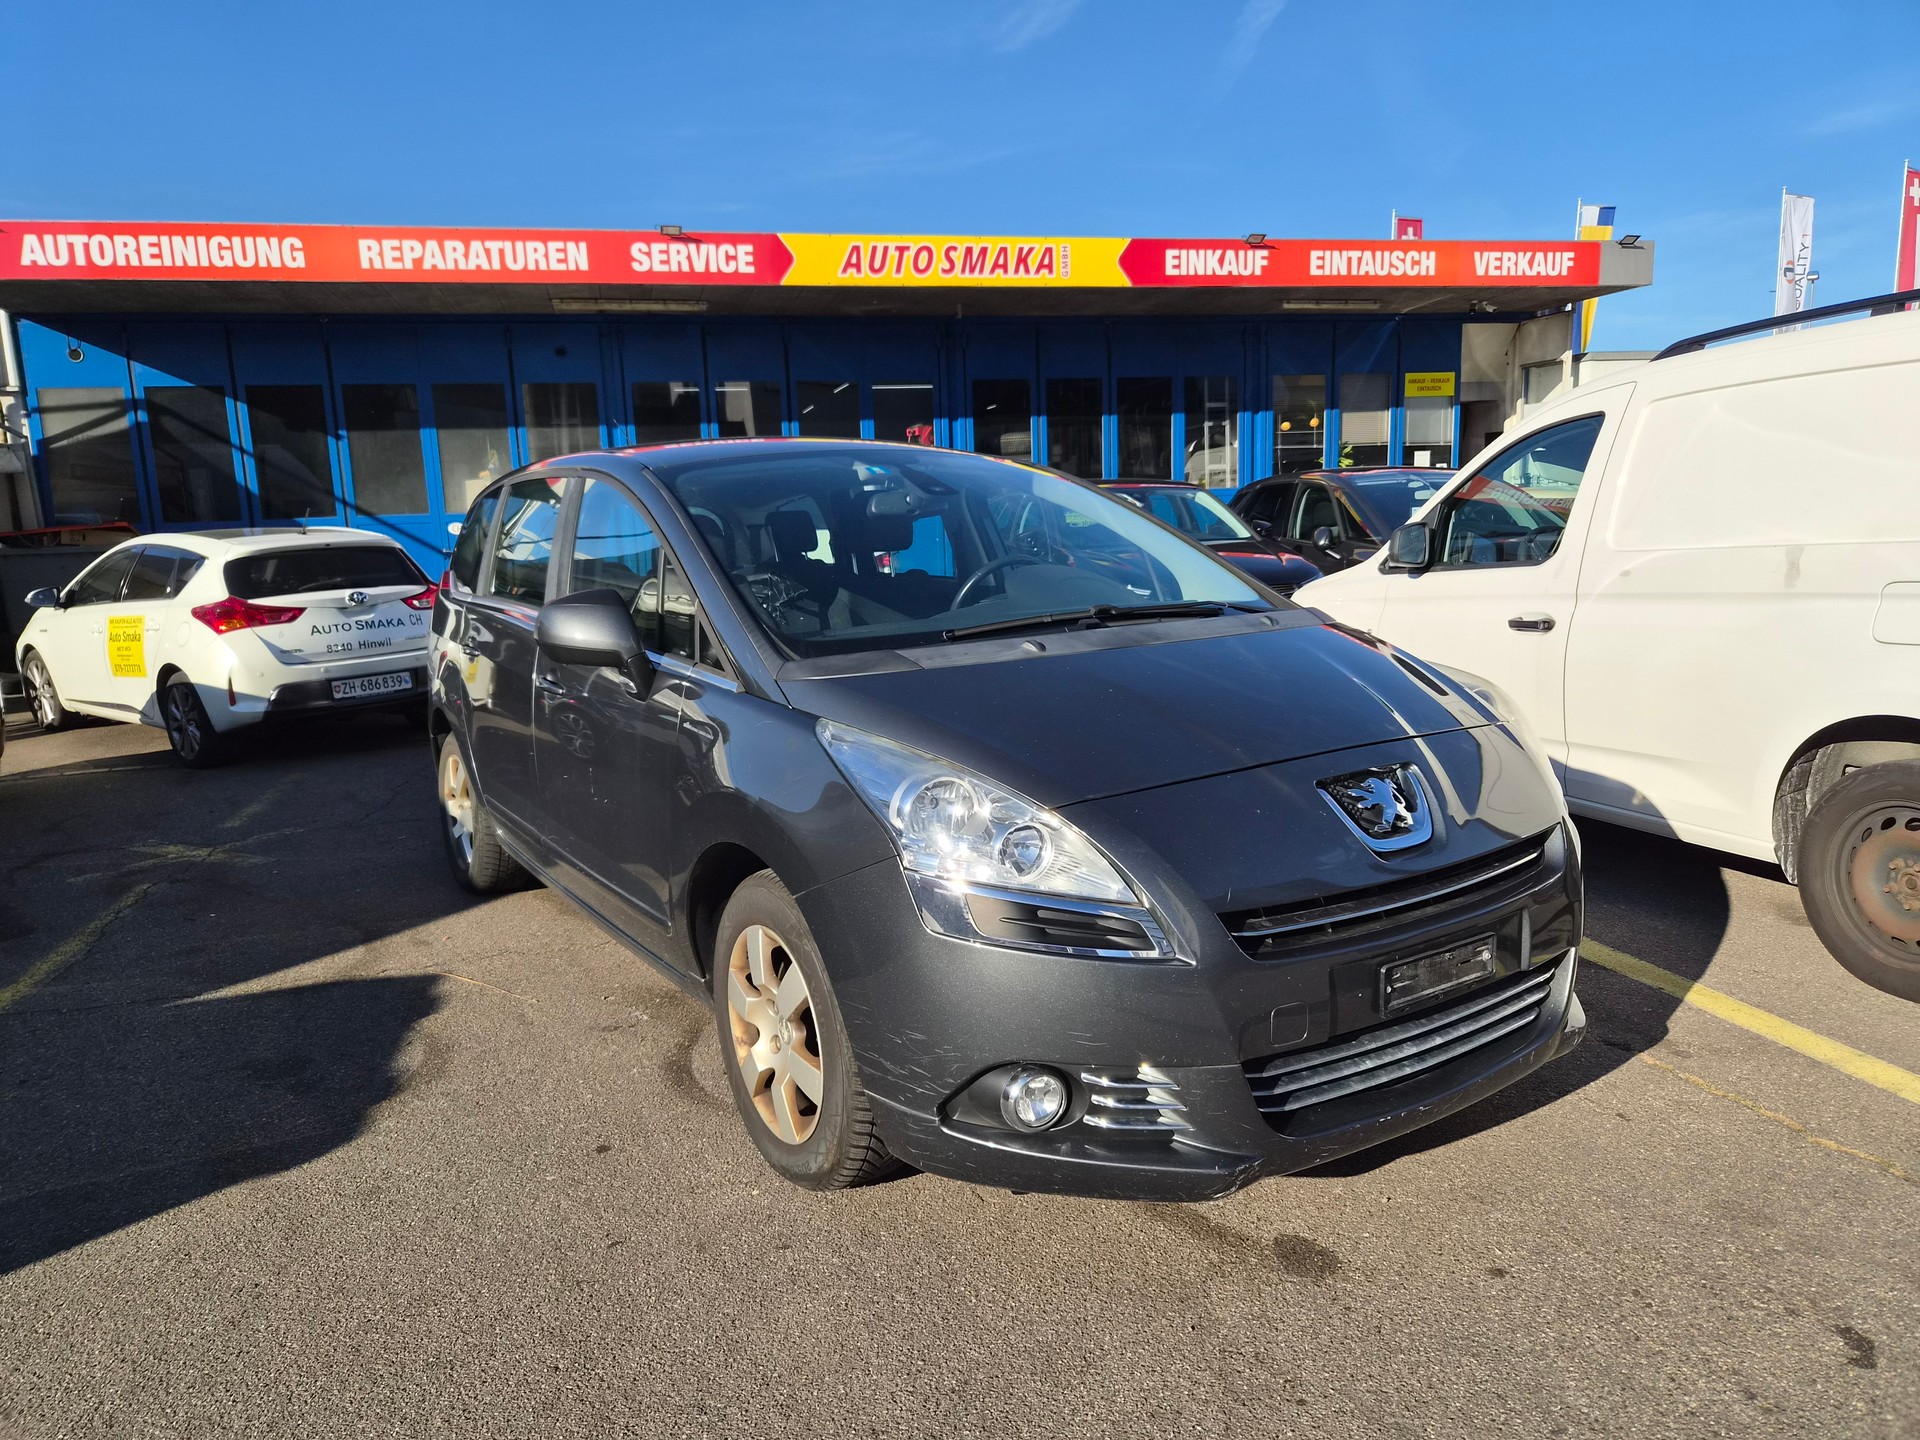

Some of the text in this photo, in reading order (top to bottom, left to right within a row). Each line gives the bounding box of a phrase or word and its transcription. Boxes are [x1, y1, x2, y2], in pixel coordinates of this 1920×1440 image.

[20, 233, 306, 269] AUTOREINIGUNG
[358, 238, 589, 271] REPARATUREN
[630, 241, 755, 274] SERVICE
[840, 244, 1055, 276] AUTO SMAKA
[1061, 245, 1070, 277] GMBH
[1165, 249, 1269, 276] EINKAUF
[1309, 250, 1436, 277] EINTAUSCH
[1474, 251, 1575, 277] VERKAUF
[109, 630, 141, 642] Auto Smaka
[311, 613, 423, 636] AUTO SMAKA CH
[326, 642, 353, 654] 8340
[358, 637, 392, 650] Hinwil
